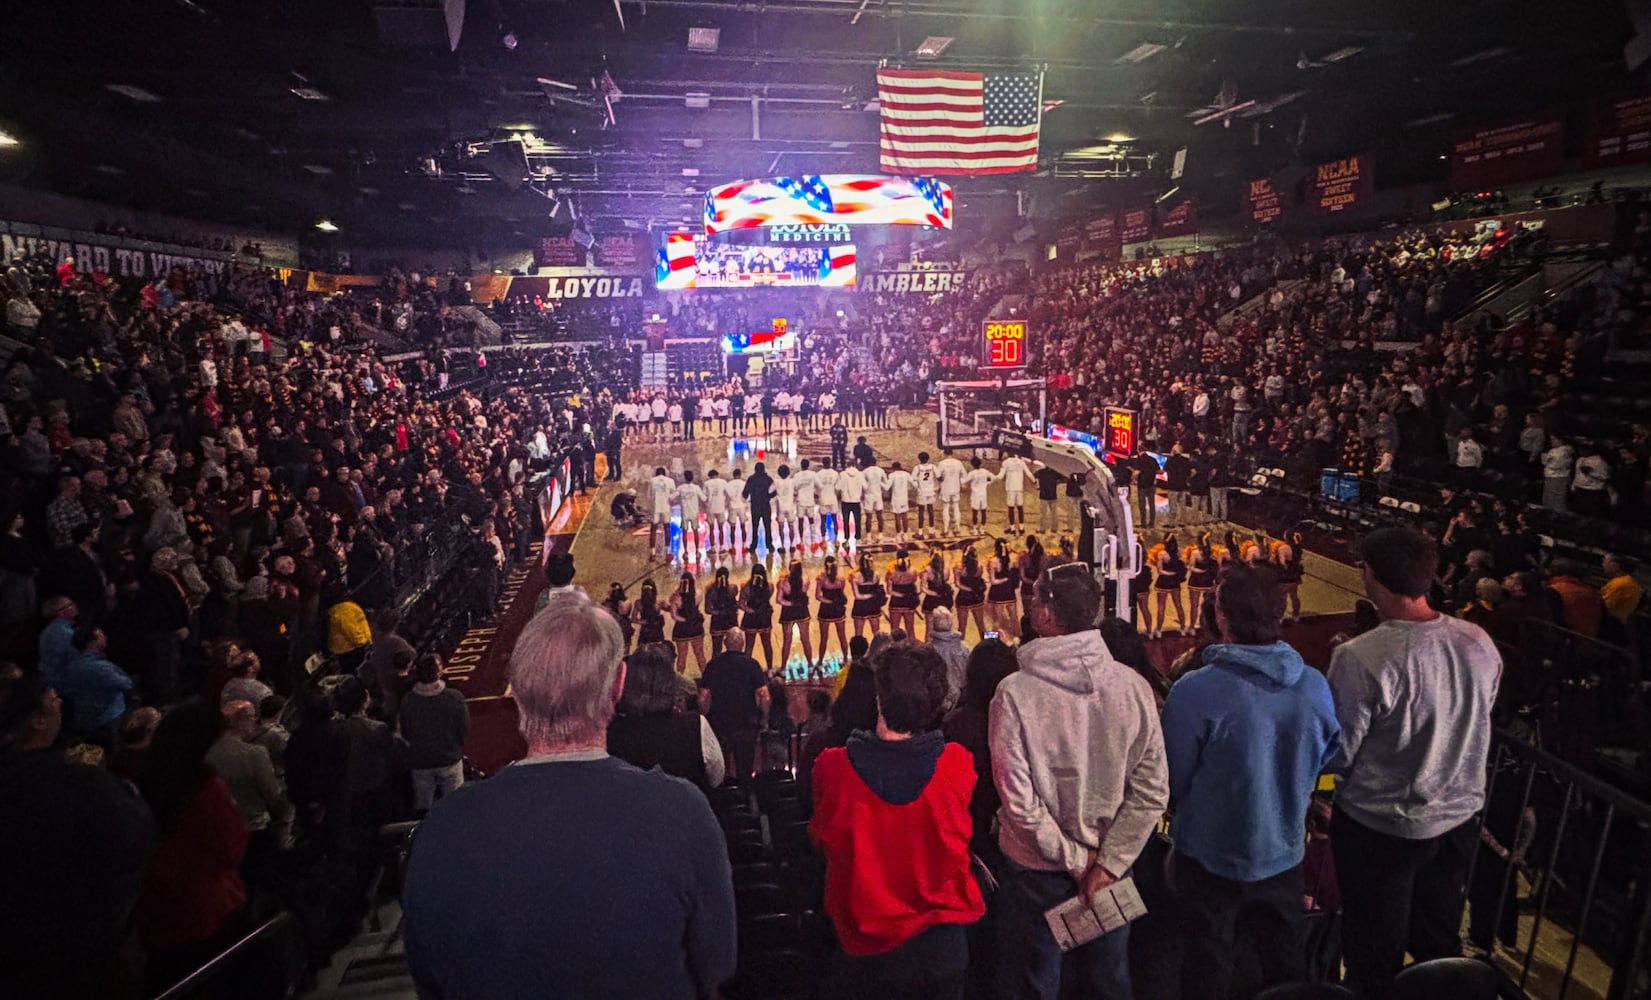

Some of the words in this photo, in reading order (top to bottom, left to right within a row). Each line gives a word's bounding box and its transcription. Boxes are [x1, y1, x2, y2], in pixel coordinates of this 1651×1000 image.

[1318, 157, 1359, 180] NCAA
[1250, 179, 1271, 196] NC
[770, 232, 851, 242] MEDICINE
[115, 249, 146, 278] TO
[547, 278, 643, 299] LOYOLA
[853, 272, 966, 293] AMBLERS
[986, 323, 1024, 341] 20:00
[991, 339, 1018, 363] 30
[1109, 413, 1132, 429] 20:00
[1113, 430, 1128, 449] 30
[922, 472, 930, 481] 2
[442, 627, 498, 681] JOSEPH
